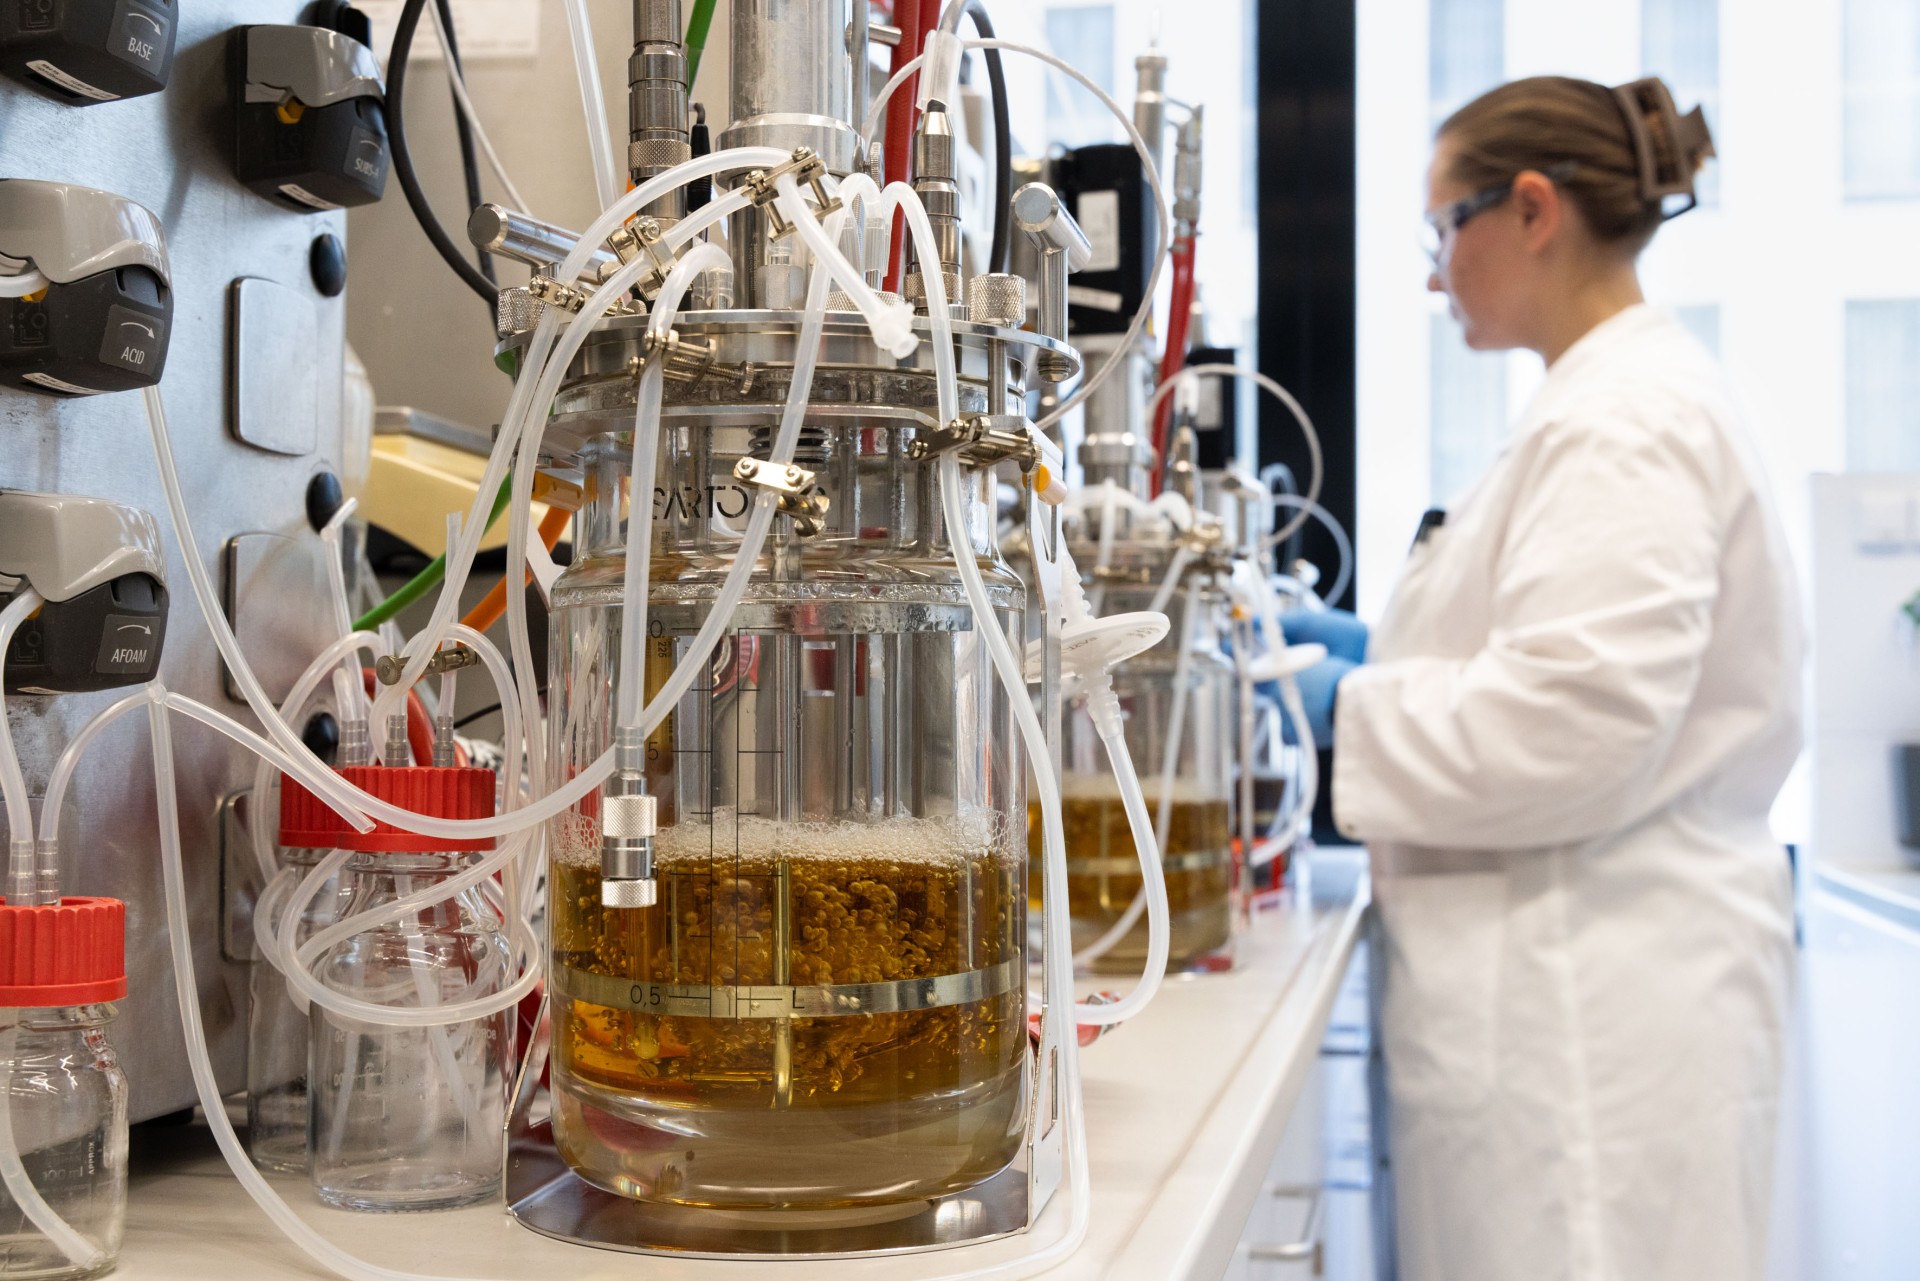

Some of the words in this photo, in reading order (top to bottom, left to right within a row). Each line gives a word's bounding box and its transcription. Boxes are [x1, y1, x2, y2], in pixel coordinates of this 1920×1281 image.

[128, 36, 153, 61] BASE
[120, 346, 145, 365] ACID
[110, 648, 148, 664] AFOAM
[630, 984, 661, 1007] 0,5
